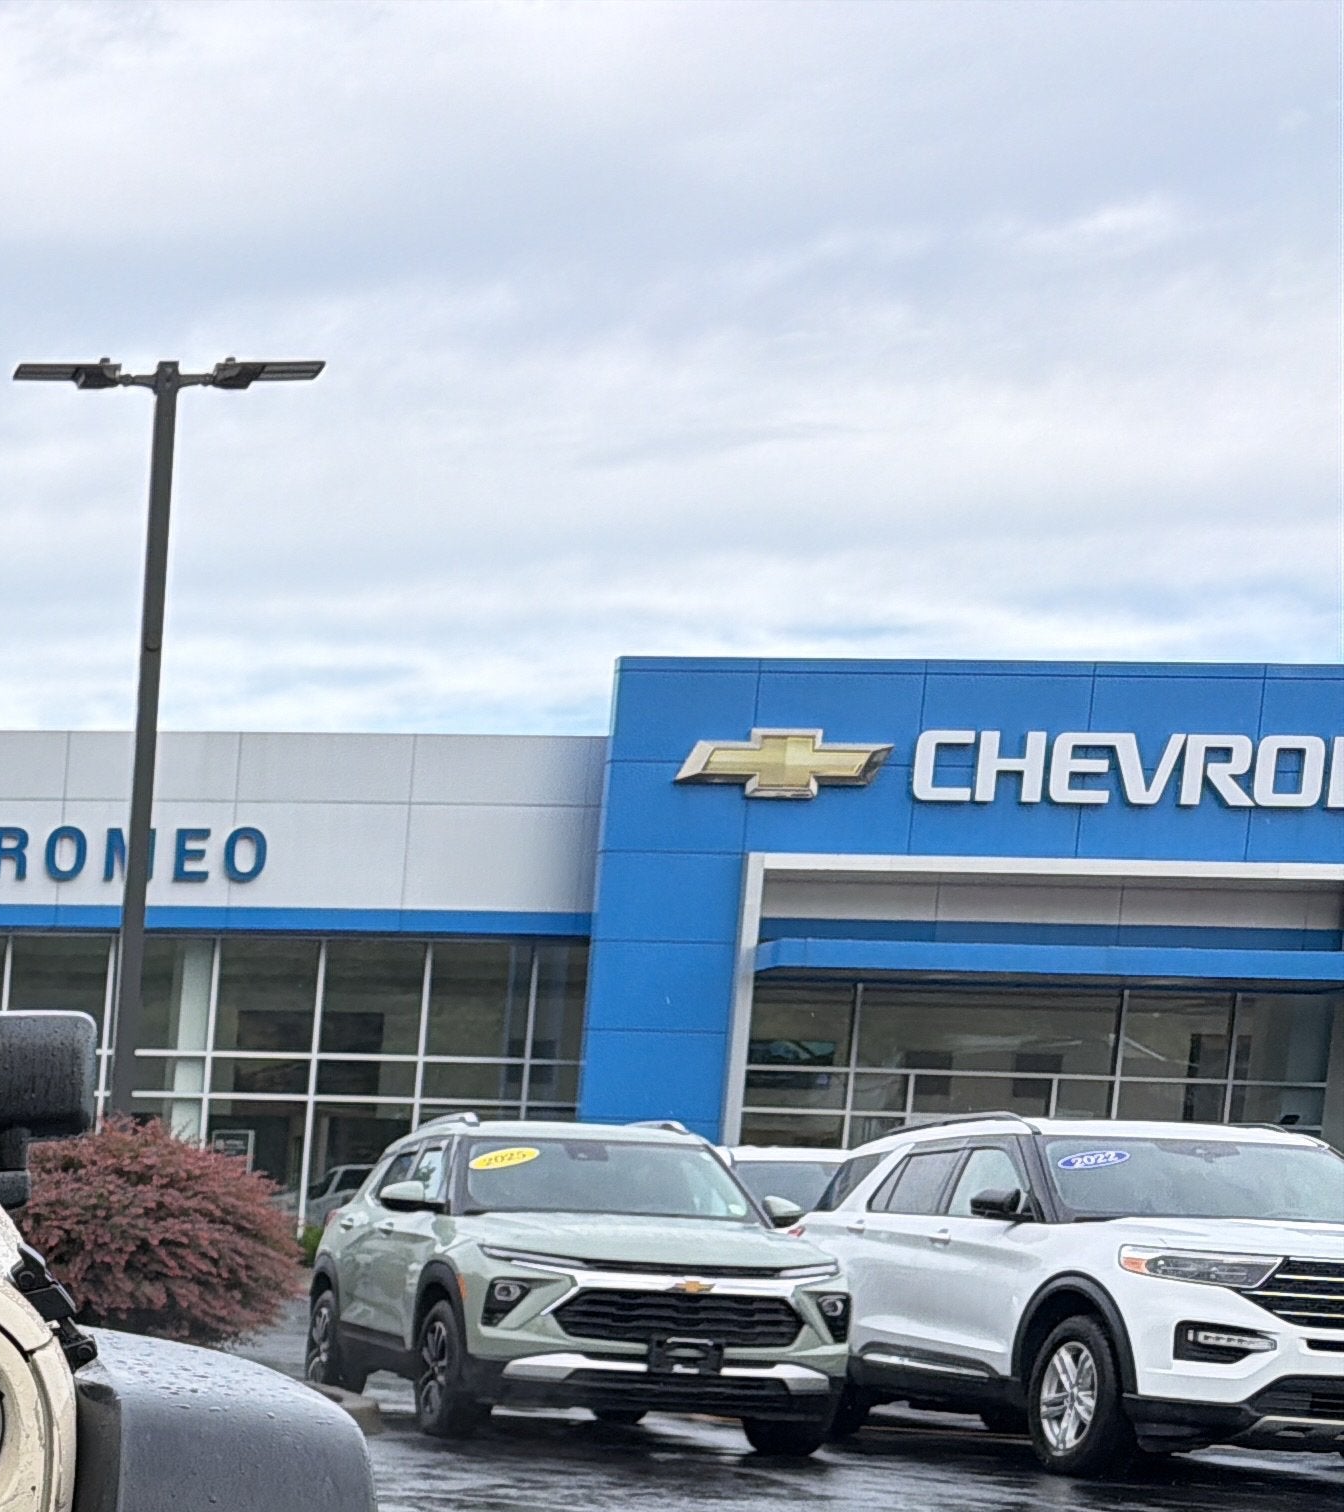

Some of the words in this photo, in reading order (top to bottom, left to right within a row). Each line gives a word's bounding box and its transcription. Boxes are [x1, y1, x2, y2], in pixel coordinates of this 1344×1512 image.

[913, 729, 1344, 809] CHEVRO
[481, 1150, 528, 1166] 2025
[1071, 1151, 1119, 1168] 2022
